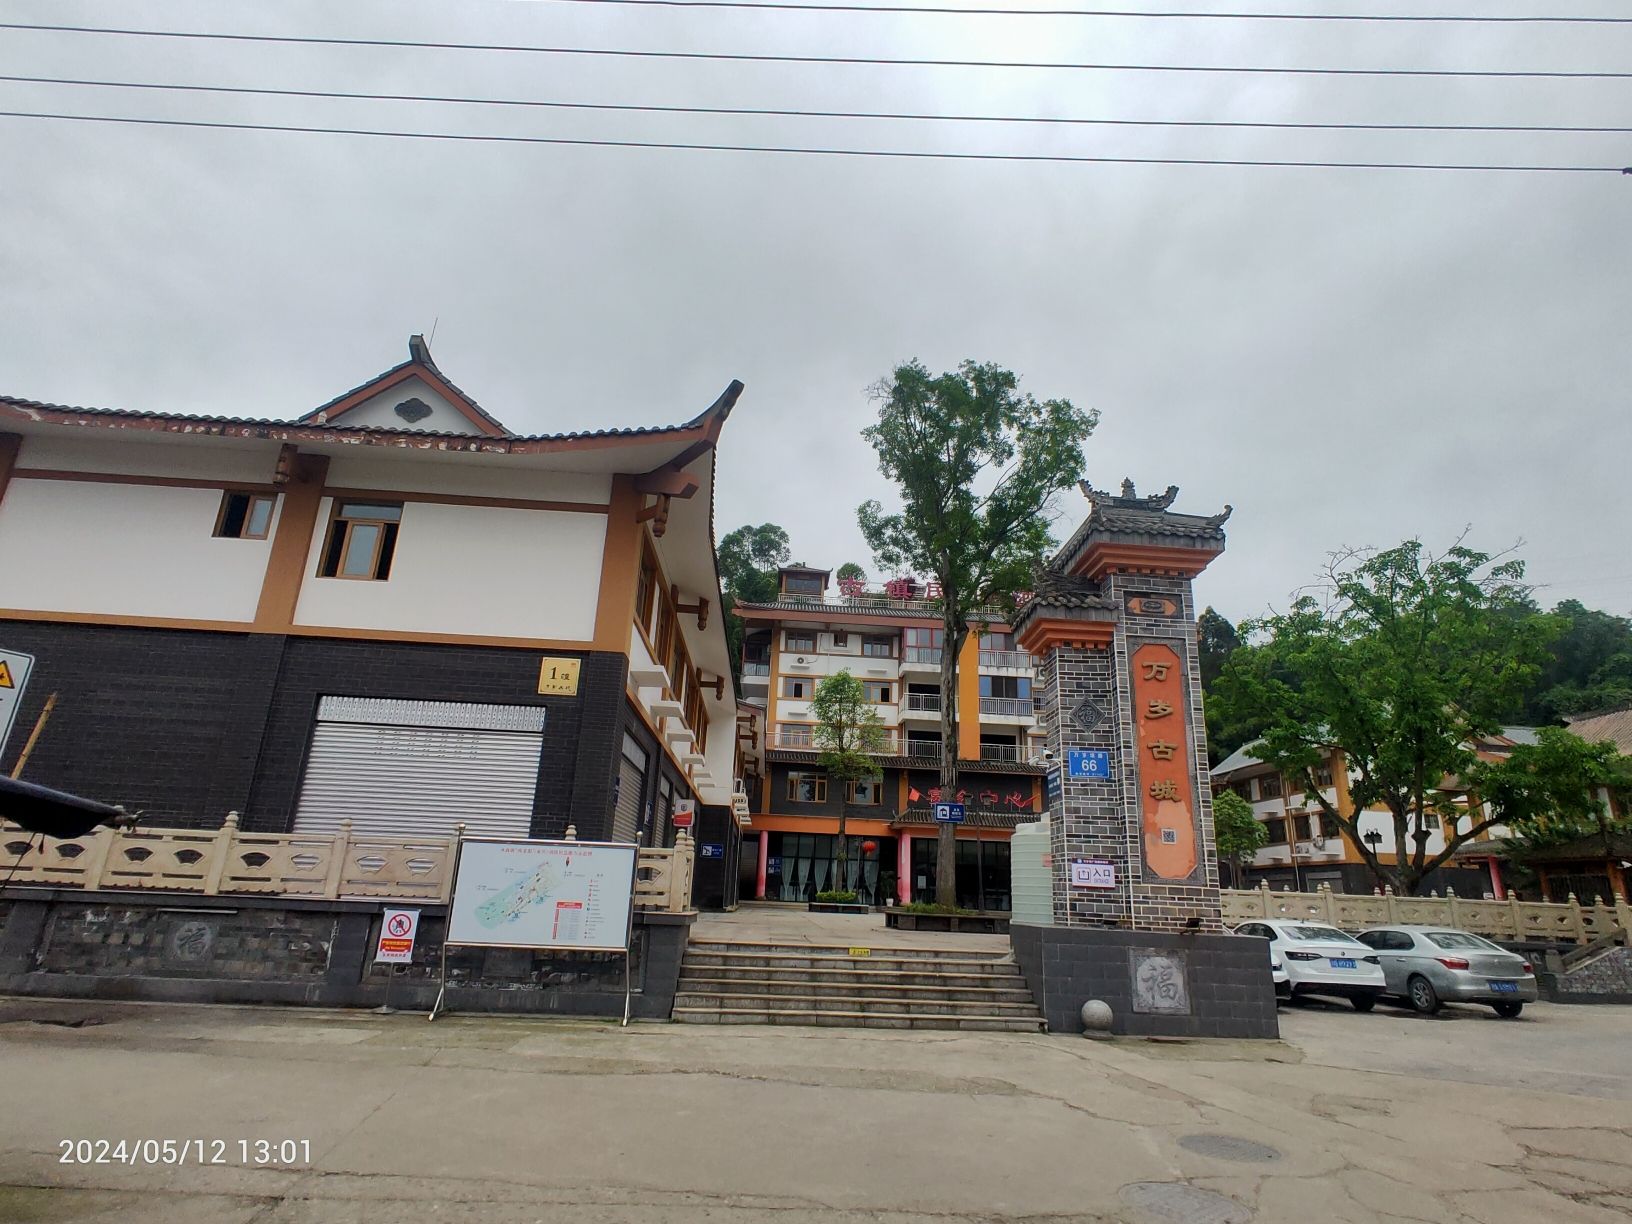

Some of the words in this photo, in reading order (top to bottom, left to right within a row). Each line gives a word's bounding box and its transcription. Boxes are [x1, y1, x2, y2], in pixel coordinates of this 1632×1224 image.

[1141, 660, 1183, 804] 万岁古城
[1081, 759, 1098, 772] 66
[1093, 867, 1111, 878] 入口
[1140, 962, 1179, 1002] 福
